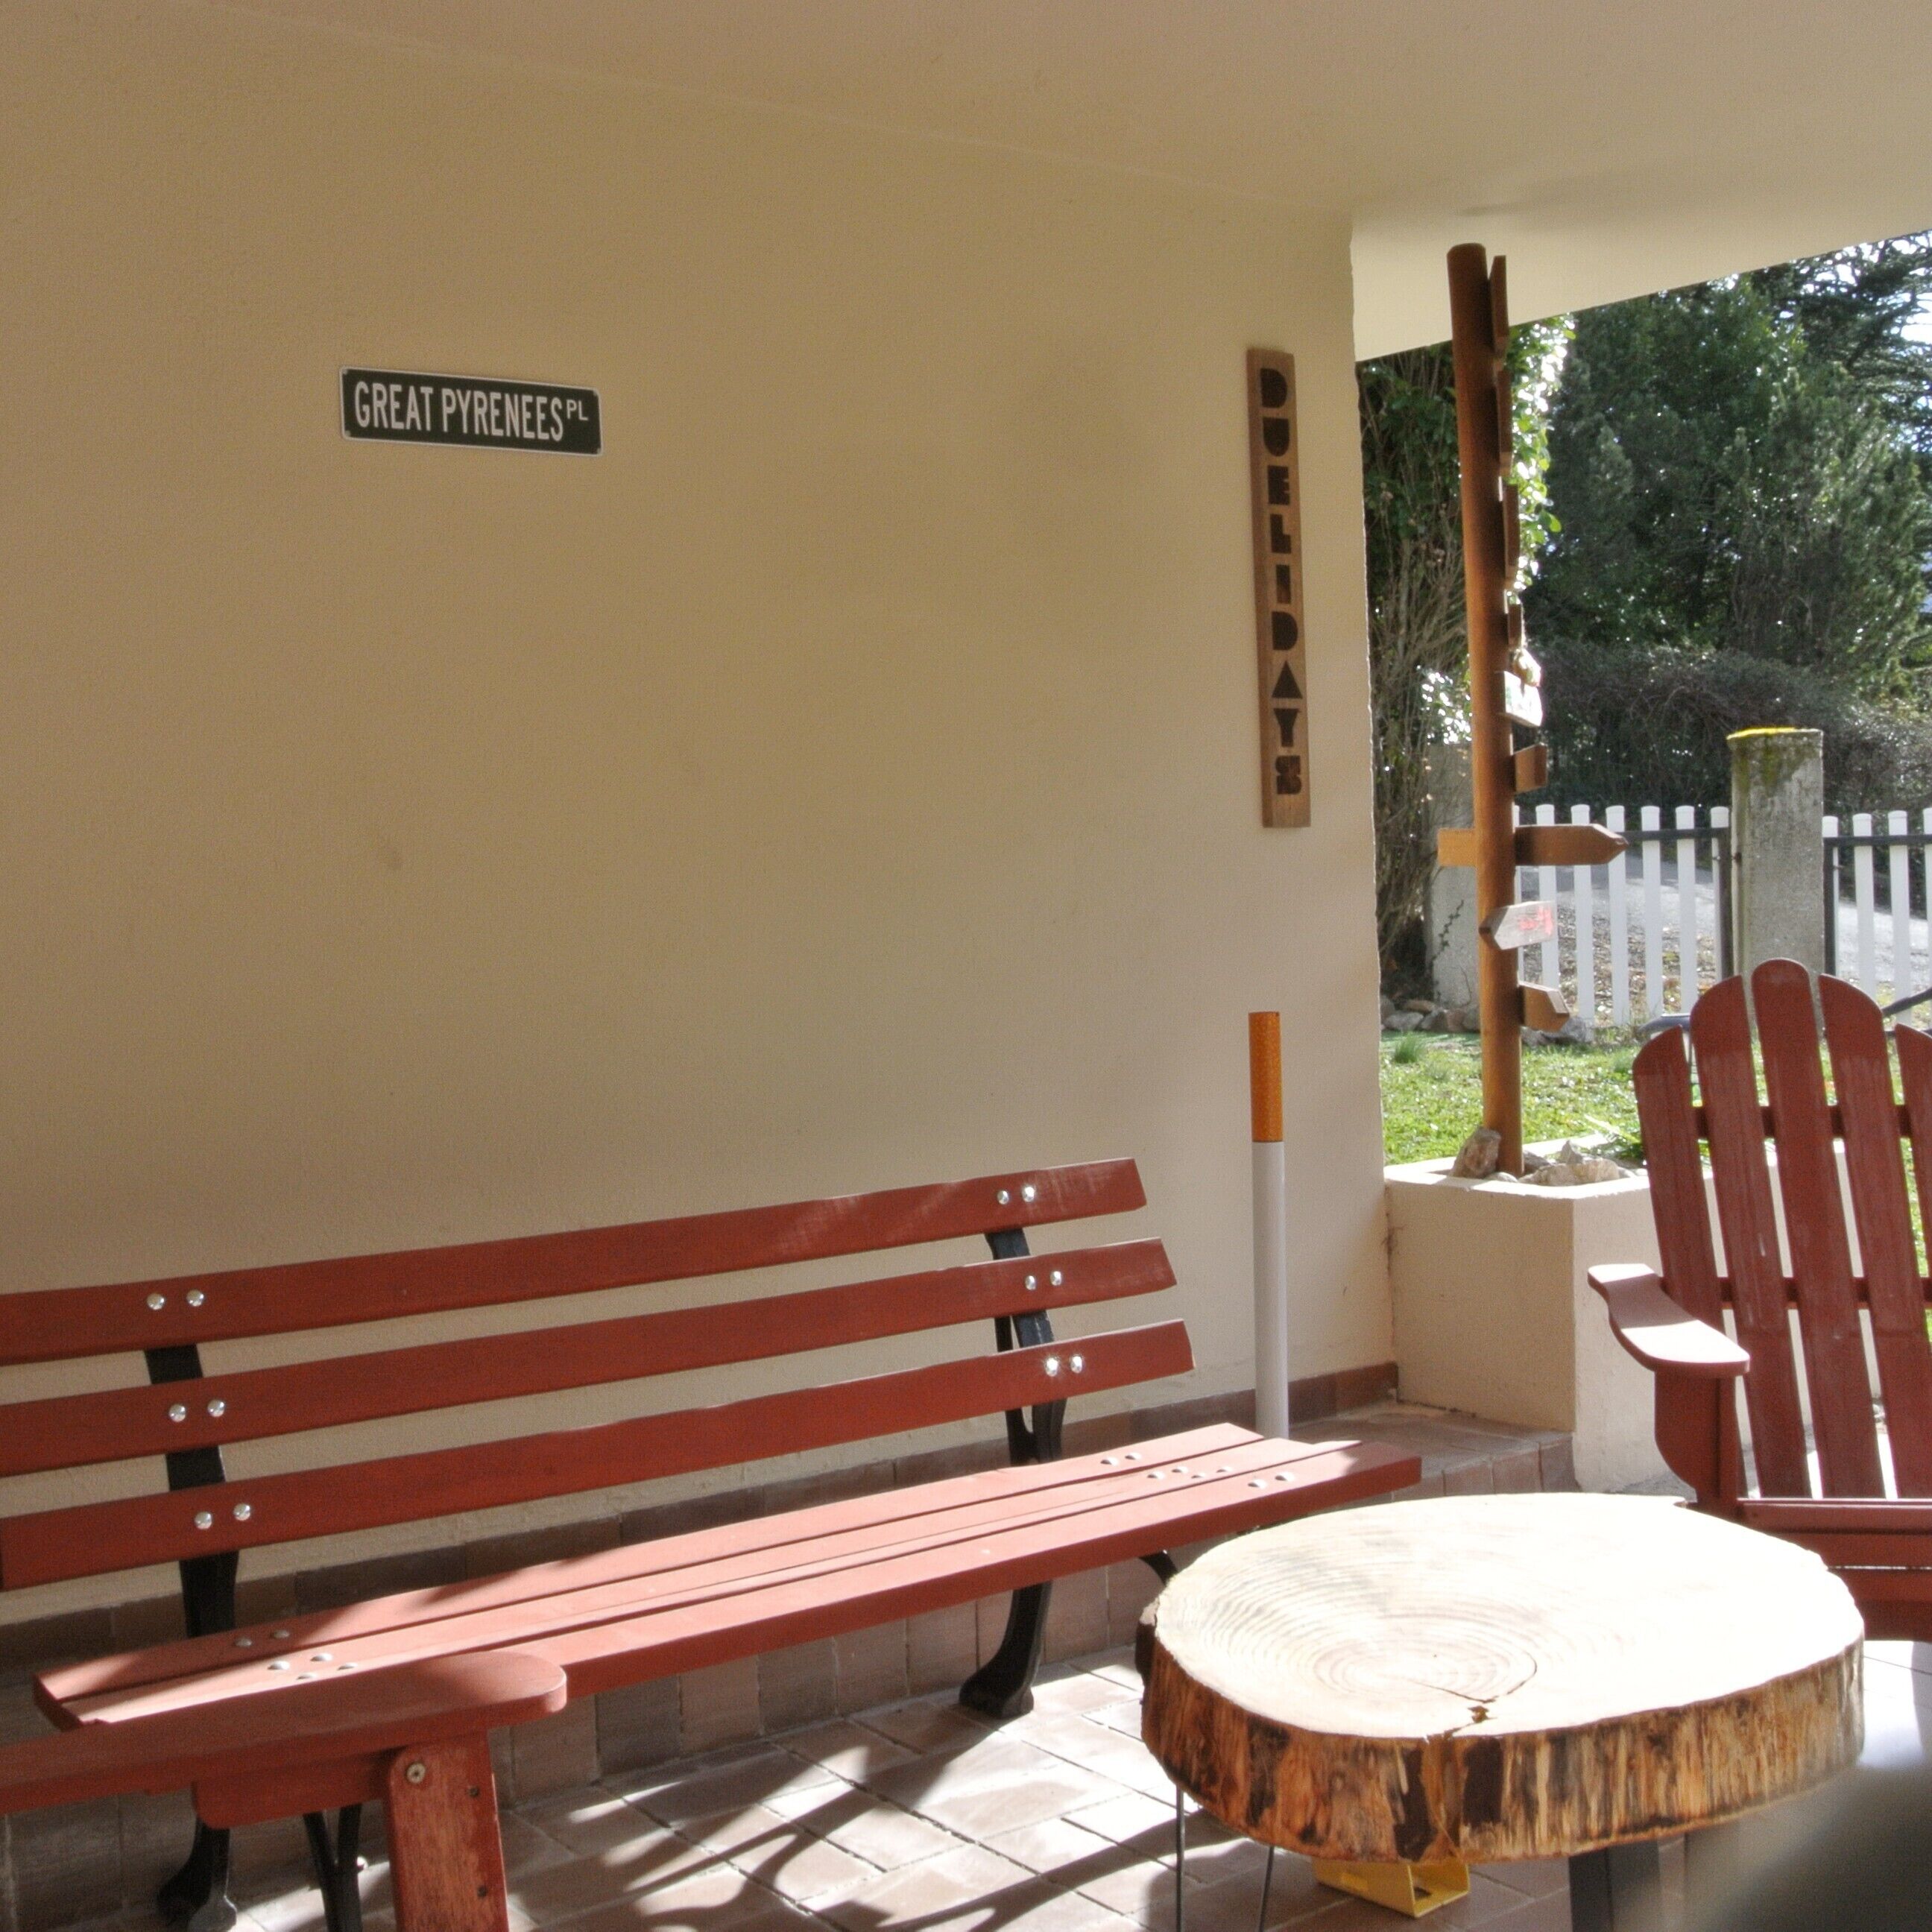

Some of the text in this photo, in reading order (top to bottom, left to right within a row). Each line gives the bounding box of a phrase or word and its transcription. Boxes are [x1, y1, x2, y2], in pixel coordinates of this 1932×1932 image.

[354, 381, 589, 442] GREAT PYRENEES PL
